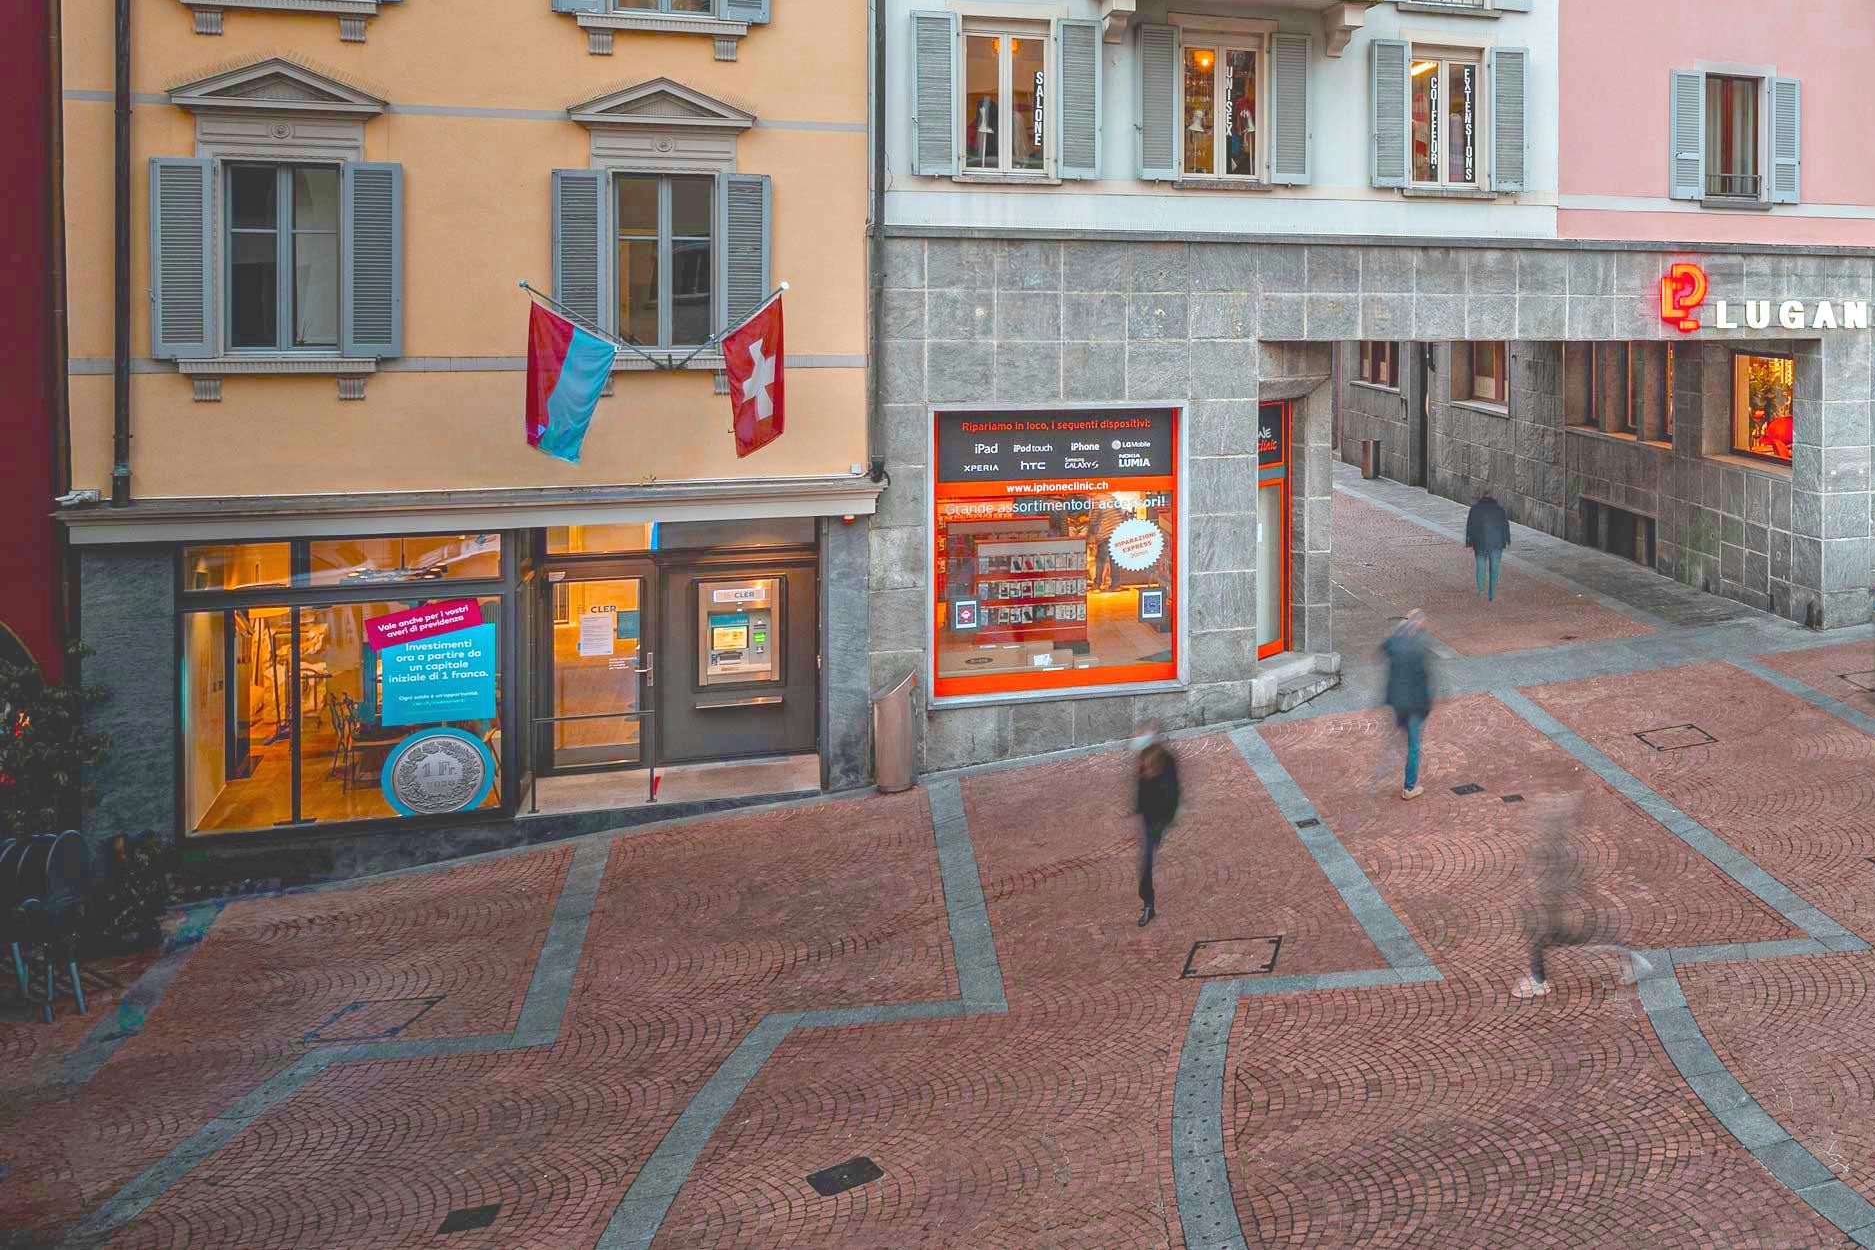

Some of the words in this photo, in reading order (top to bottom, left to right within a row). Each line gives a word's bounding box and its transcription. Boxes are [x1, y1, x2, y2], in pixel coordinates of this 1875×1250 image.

[1034, 71, 1043, 146] SALONE
[1464, 68, 1472, 180] EXTENSIONS
[962, 422, 1013, 433] Ripariamo
[1015, 422, 1024, 430] in
[1057, 420, 1098, 430] seguenti
[1100, 418, 1151, 429] dispositivi:
[974, 442, 999, 454] iPad
[1013, 444, 1031, 453] iPod
[1032, 443, 1053, 452] touch
[1070, 442, 1100, 451] iPhone
[964, 463, 1000, 472] XPERIA
[1118, 458, 1151, 468] LUMIA
[1006, 481, 1109, 494] www.iphoneclinic.ch
[944, 502, 995, 516] Grande
[734, 591, 755, 599] CLER
[590, 605, 617, 614] CLER
[378, 623, 397, 632] Vale
[398, 616, 424, 627] anche
[425, 613, 439, 623] per
[444, 604, 469, 616] vostri
[386, 627, 409, 638] averi
[409, 623, 418, 633] di
[418, 614, 464, 632] previdenza
[405, 639, 472, 651] Investimenti
[427, 650, 465, 663] partire
[467, 649, 481, 658] da
[425, 660, 469, 672] capitale
[389, 672, 426, 683] iniziale
[428, 672, 439, 681] di
[441, 671, 449, 680] 1
[451, 669, 489, 679] franco.
